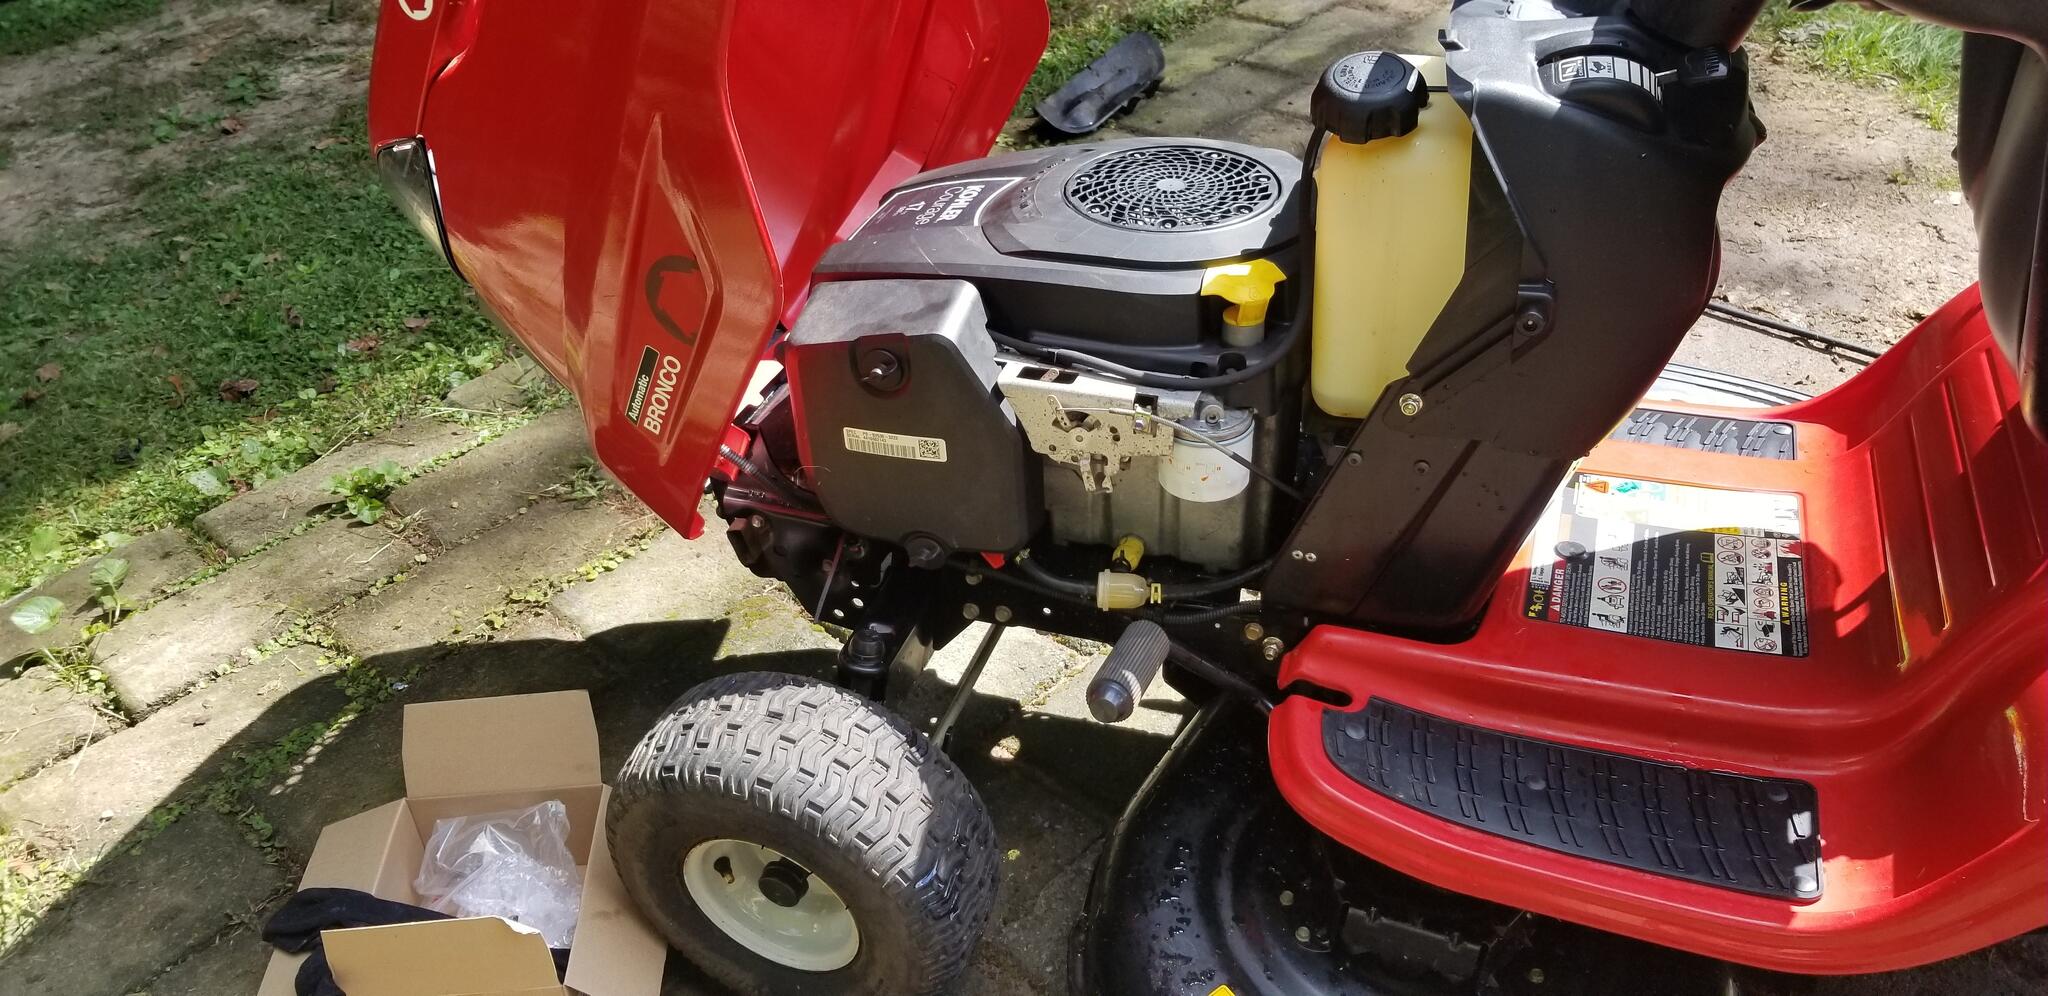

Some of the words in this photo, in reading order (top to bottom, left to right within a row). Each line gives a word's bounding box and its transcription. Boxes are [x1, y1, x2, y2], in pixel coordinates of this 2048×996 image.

[905, 200, 926, 212] 17
[914, 186, 964, 225] Courage
[933, 184, 986, 223] KOHLER
[628, 374, 649, 421] Automatic
[643, 355, 681, 435] BRONCO
[1552, 568, 1564, 603] DANGER
[1780, 582, 1790, 618] WARNING
